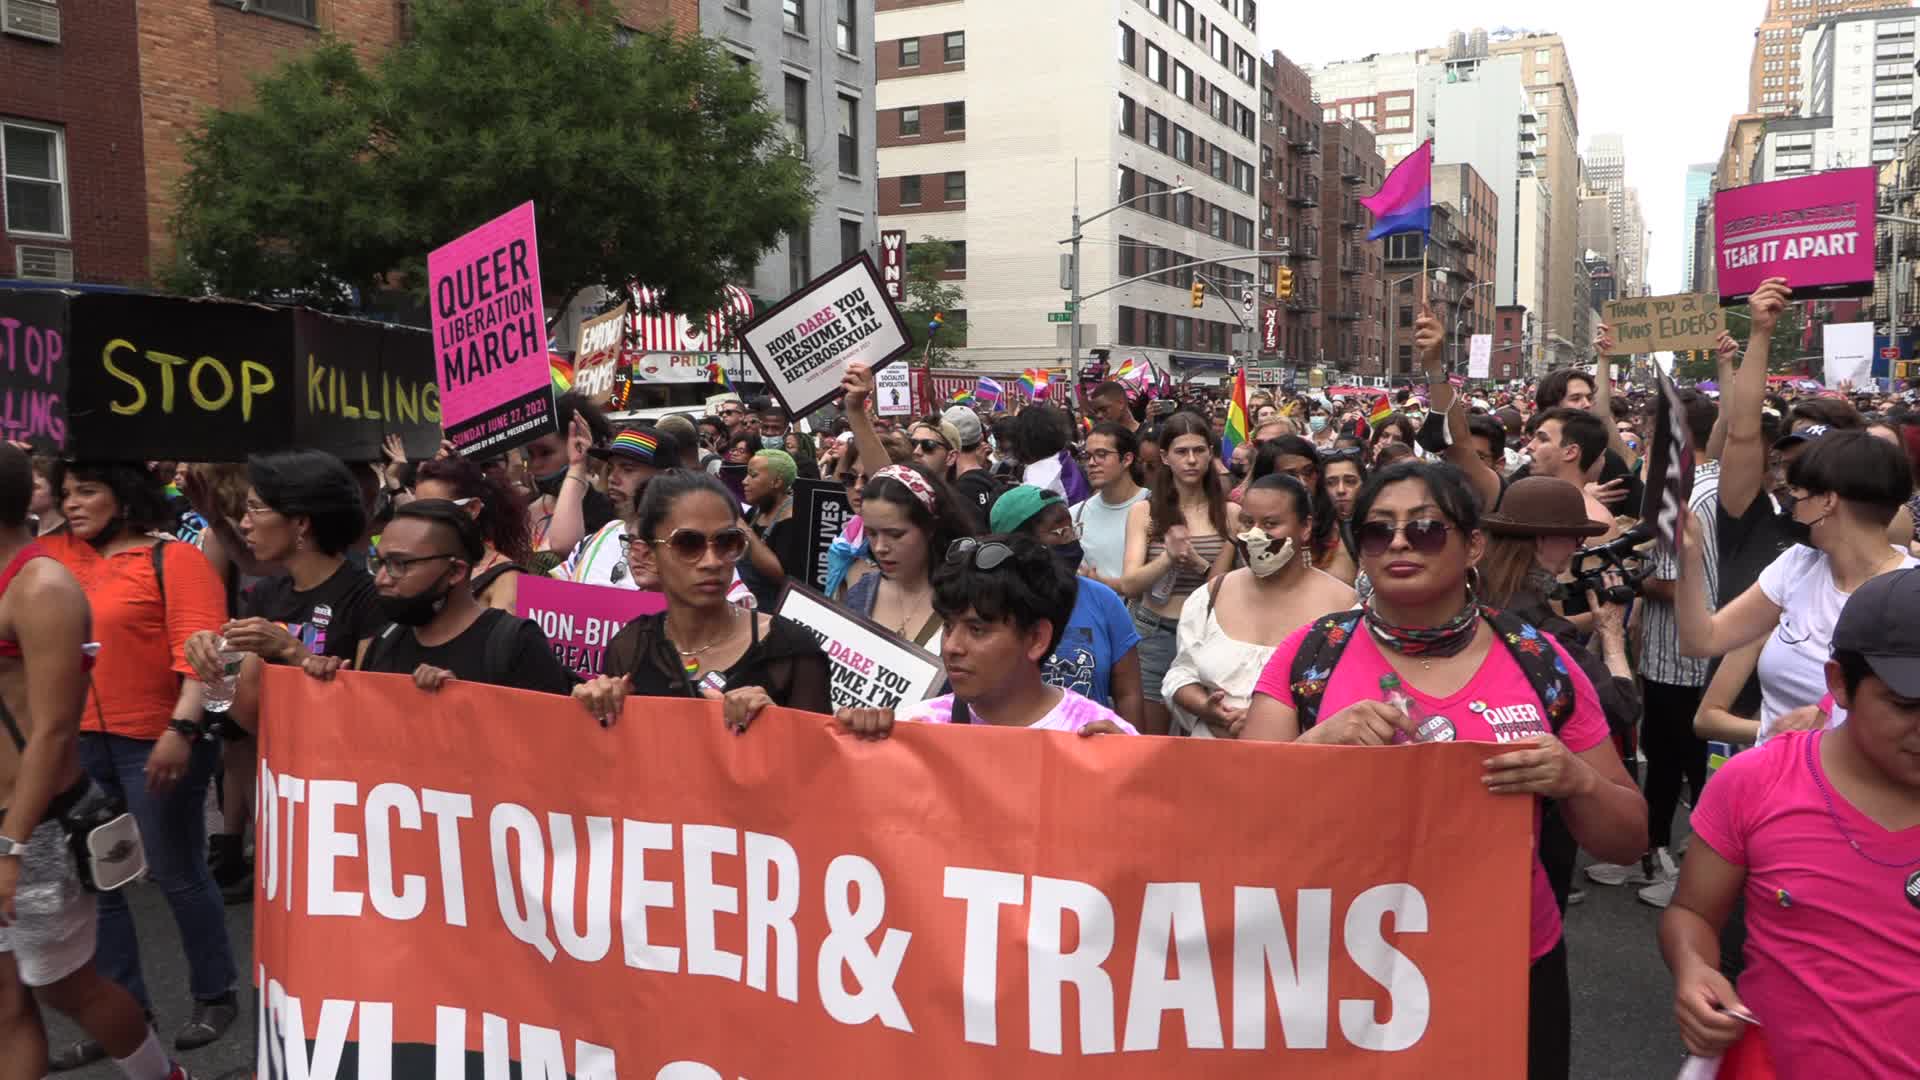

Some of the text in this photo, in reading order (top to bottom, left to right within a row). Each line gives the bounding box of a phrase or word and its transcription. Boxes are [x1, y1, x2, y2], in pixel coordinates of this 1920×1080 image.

[438, 238, 530, 320] QUEER
[883, 234, 901, 297] WINE
[1723, 231, 1860, 269] TEAR IT APART
[440, 283, 534, 350] LIBERATION
[765, 287, 866, 356] HOW DARE YOU
[774, 318, 846, 372] PRESUME
[844, 300, 875, 328] I'M
[1265, 309, 1277, 348] NAILS
[1607, 301, 1648, 317] THANK
[1652, 301, 1675, 315] YOU
[1659, 312, 1718, 338] ELDERS
[0, 317, 64, 385] TOP
[102, 338, 275, 422] STOP
[443, 313, 539, 392] MARCH
[670, 354, 717, 367] PRIDE
[697, 368, 708, 377] by
[782, 317, 883, 384] HETEROSEXUAL
[308, 353, 441, 424] KILLING
[452, 423, 488, 446] SUNDAY
[488, 410, 508, 433] JUNE
[526, 397, 547, 417] 2021
[819, 500, 840, 548] LIVES
[827, 639, 875, 676] DARE
[877, 665, 912, 695] YOU
[1483, 704, 1540, 725] QUEER
[255, 758, 473, 927] OTECT
[489, 802, 1430, 1055] QUEER & TRANS
